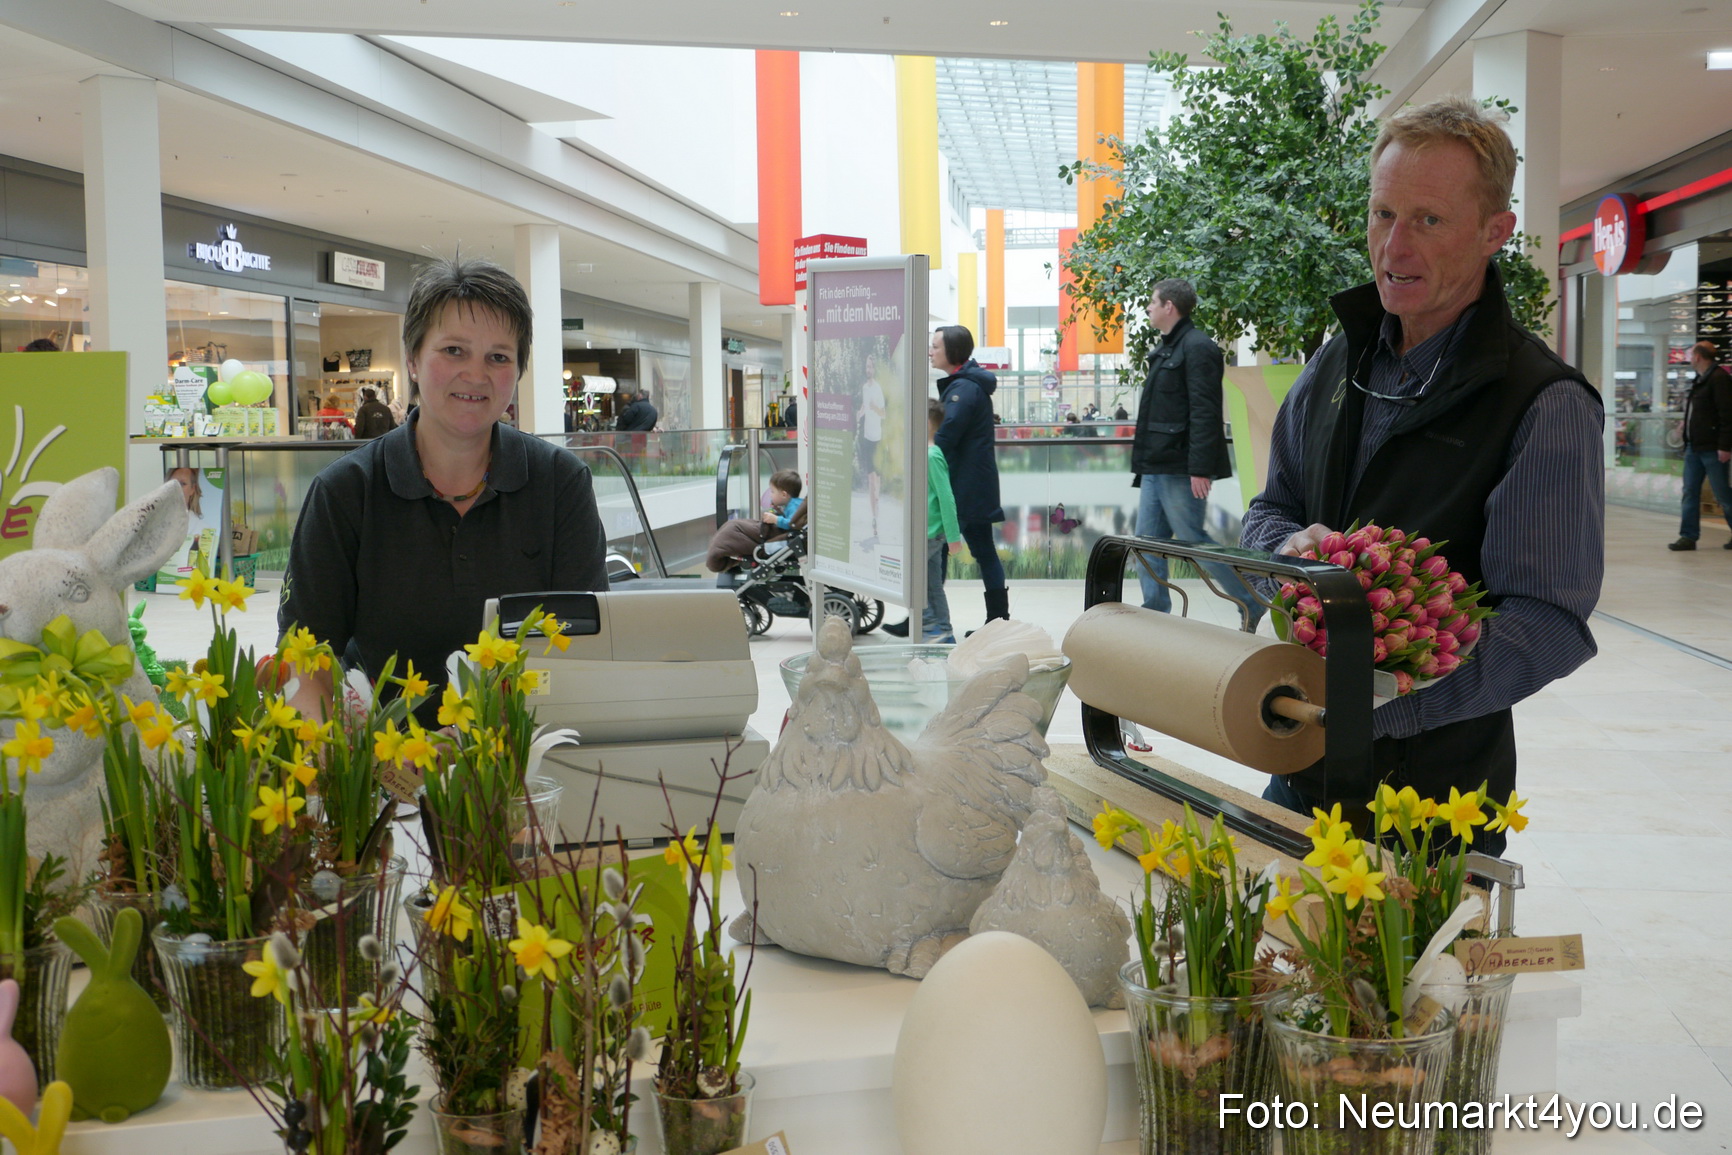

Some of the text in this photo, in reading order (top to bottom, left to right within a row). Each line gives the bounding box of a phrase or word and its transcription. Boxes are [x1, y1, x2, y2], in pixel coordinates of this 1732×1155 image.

[1594, 214, 1625, 256] Hervis
[196, 242, 222, 263] BIJOU
[819, 288, 827, 300] Fit
[827, 287, 834, 299] in
[834, 287, 846, 299] den
[845, 285, 871, 299] Frühling
[826, 305, 842, 323] mit
[843, 304, 864, 322] dem
[865, 302, 901, 321] Neuen.
[1489, 957, 1555, 967] HABERLER
